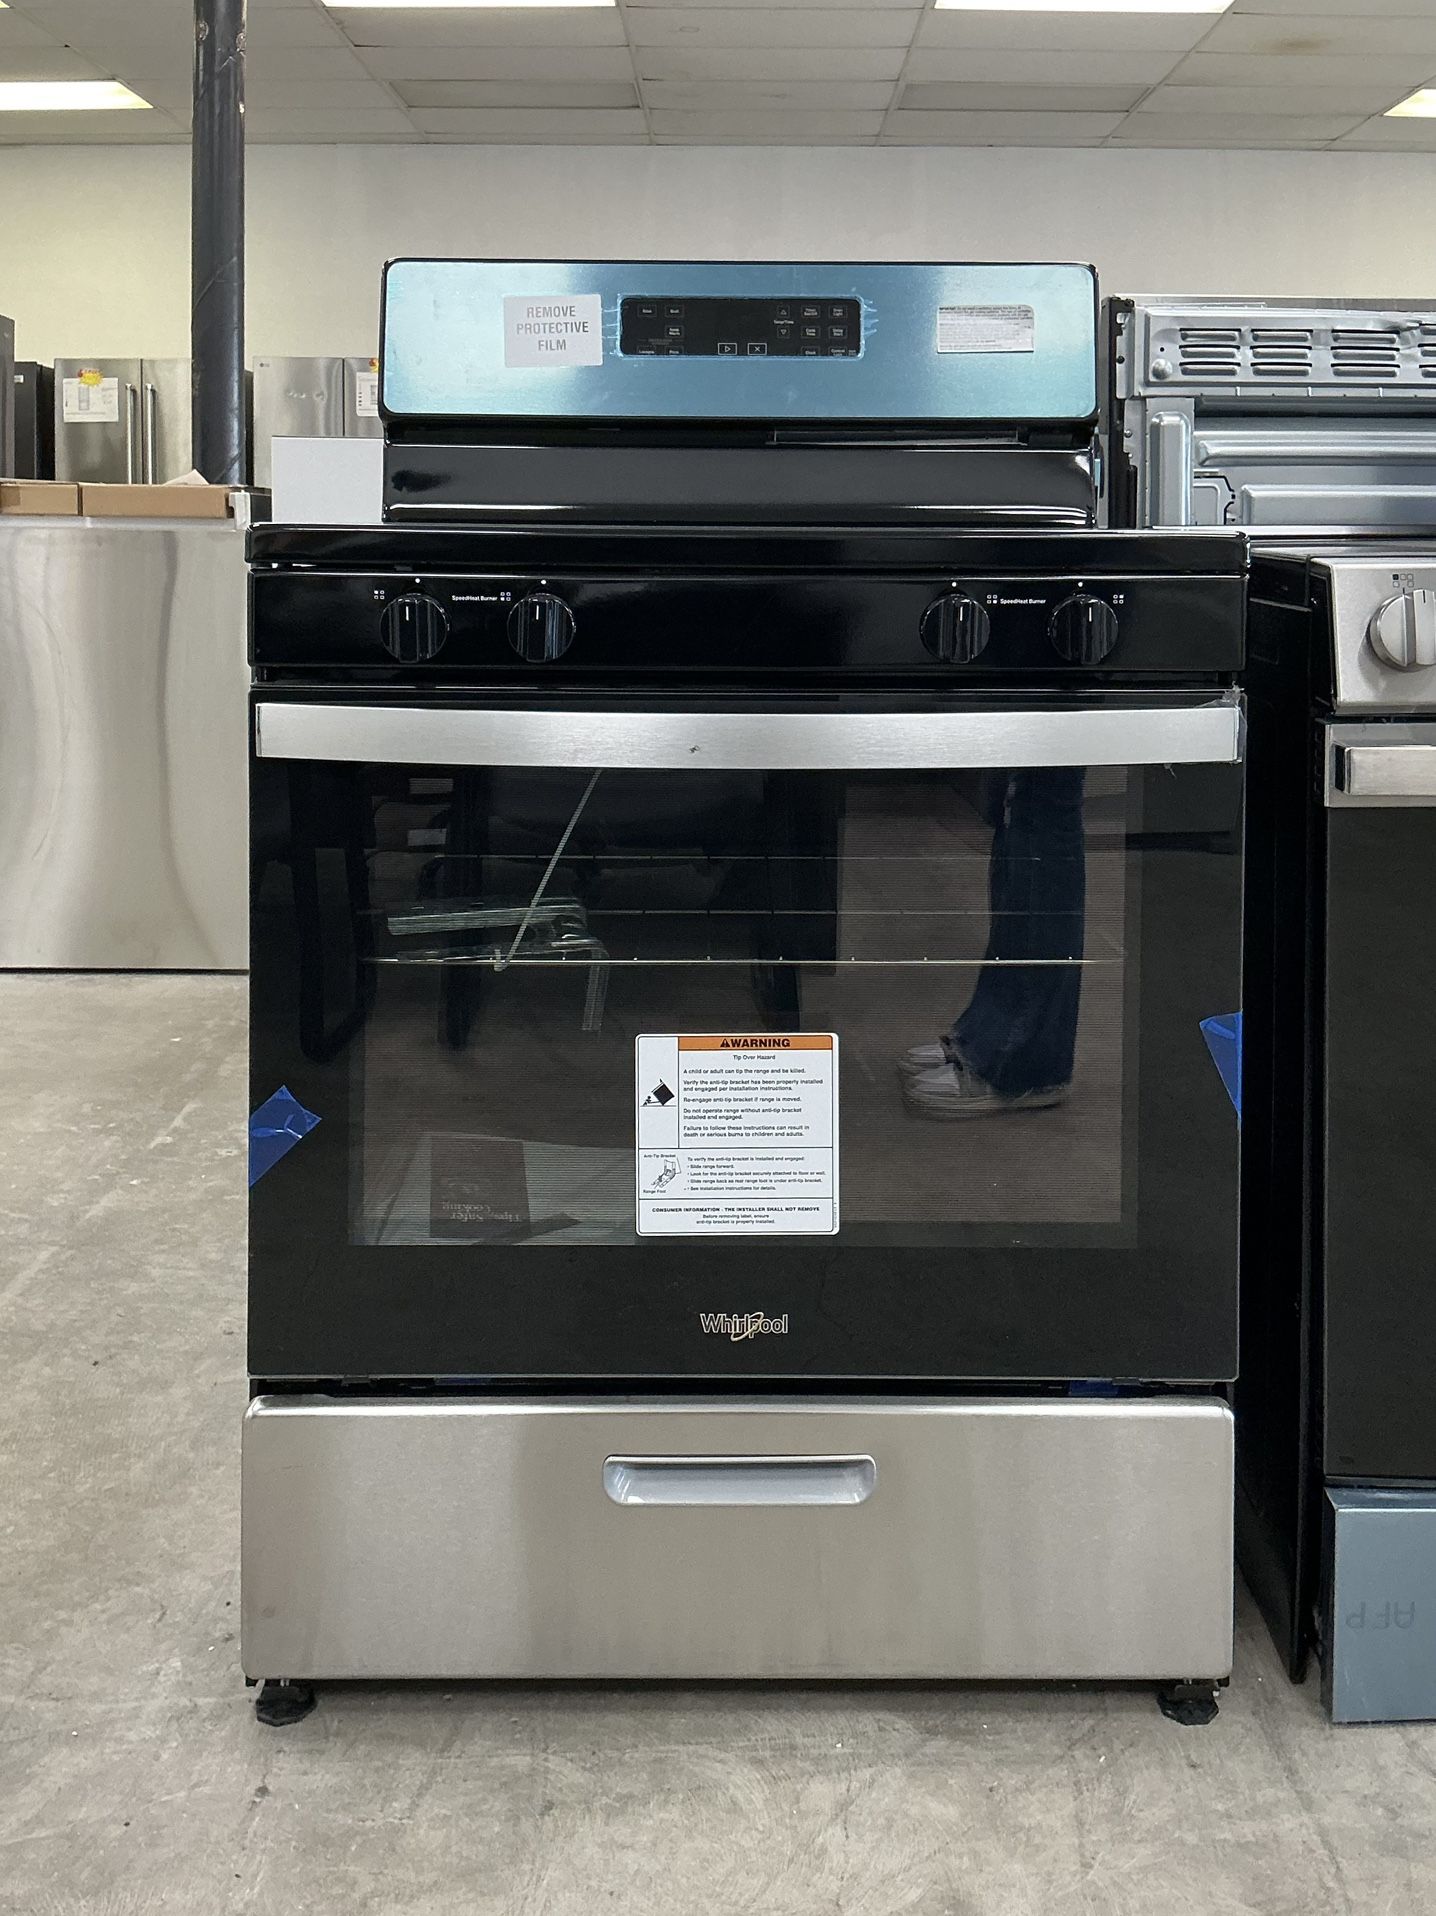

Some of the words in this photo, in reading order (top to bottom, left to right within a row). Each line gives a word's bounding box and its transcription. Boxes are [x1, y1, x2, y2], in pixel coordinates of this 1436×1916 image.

[527, 306, 576, 319] REMOVE
[516, 321, 589, 335] PROTECTIVE
[538, 339, 567, 351] FILM
[730, 1038, 791, 1048] WARNING
[700, 1311, 789, 1342] Whirlpool
